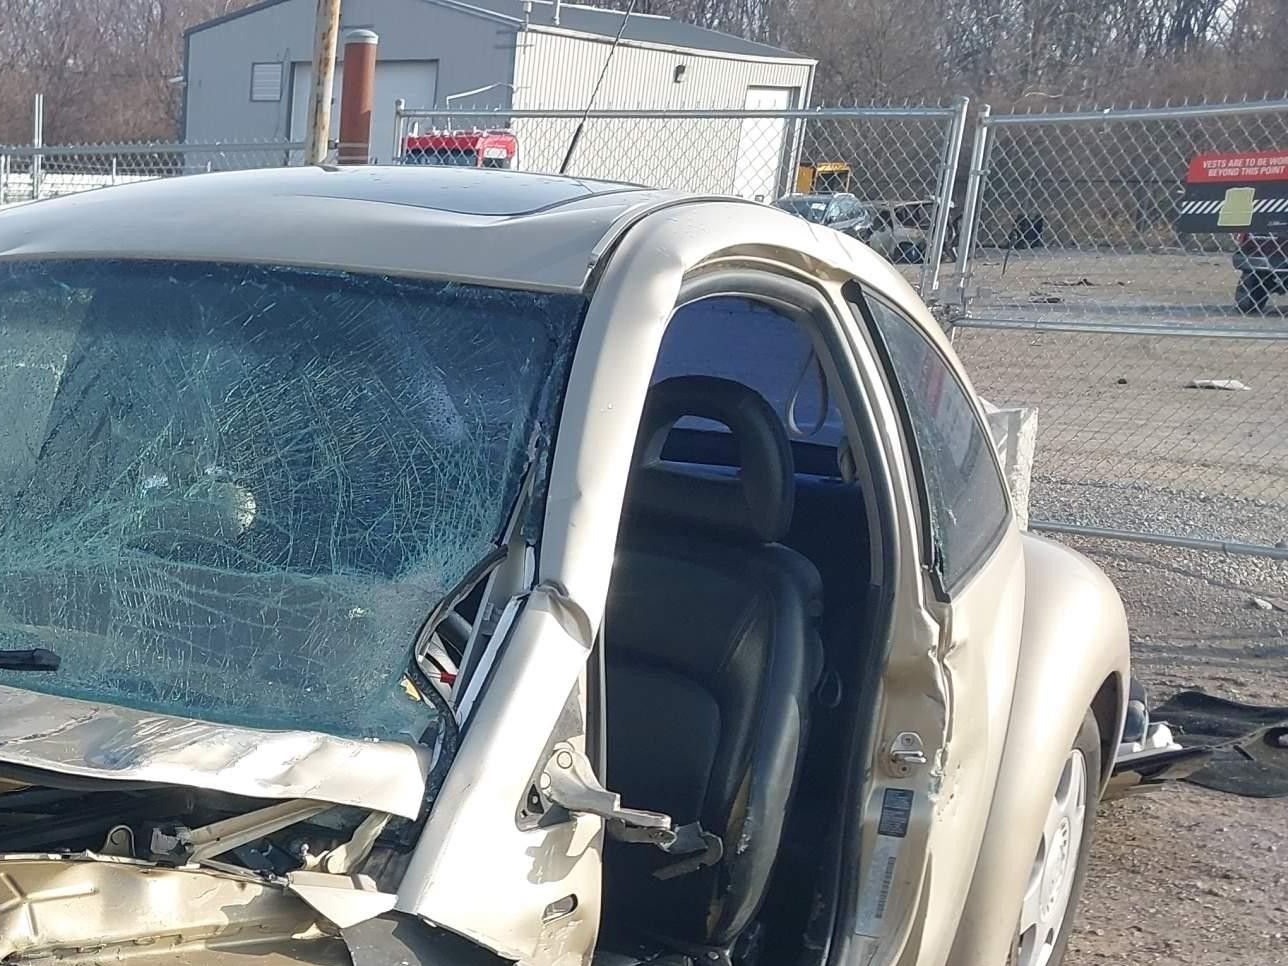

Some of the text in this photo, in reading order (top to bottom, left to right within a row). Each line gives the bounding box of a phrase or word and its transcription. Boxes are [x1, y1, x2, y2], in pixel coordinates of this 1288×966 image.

[1203, 160, 1226, 168] VESTS
[1228, 159, 1243, 167] ARE
[1245, 158, 1256, 167] TO
[1257, 158, 1268, 166] BE
[1208, 166, 1285, 176] BEYOND THIS POINT
